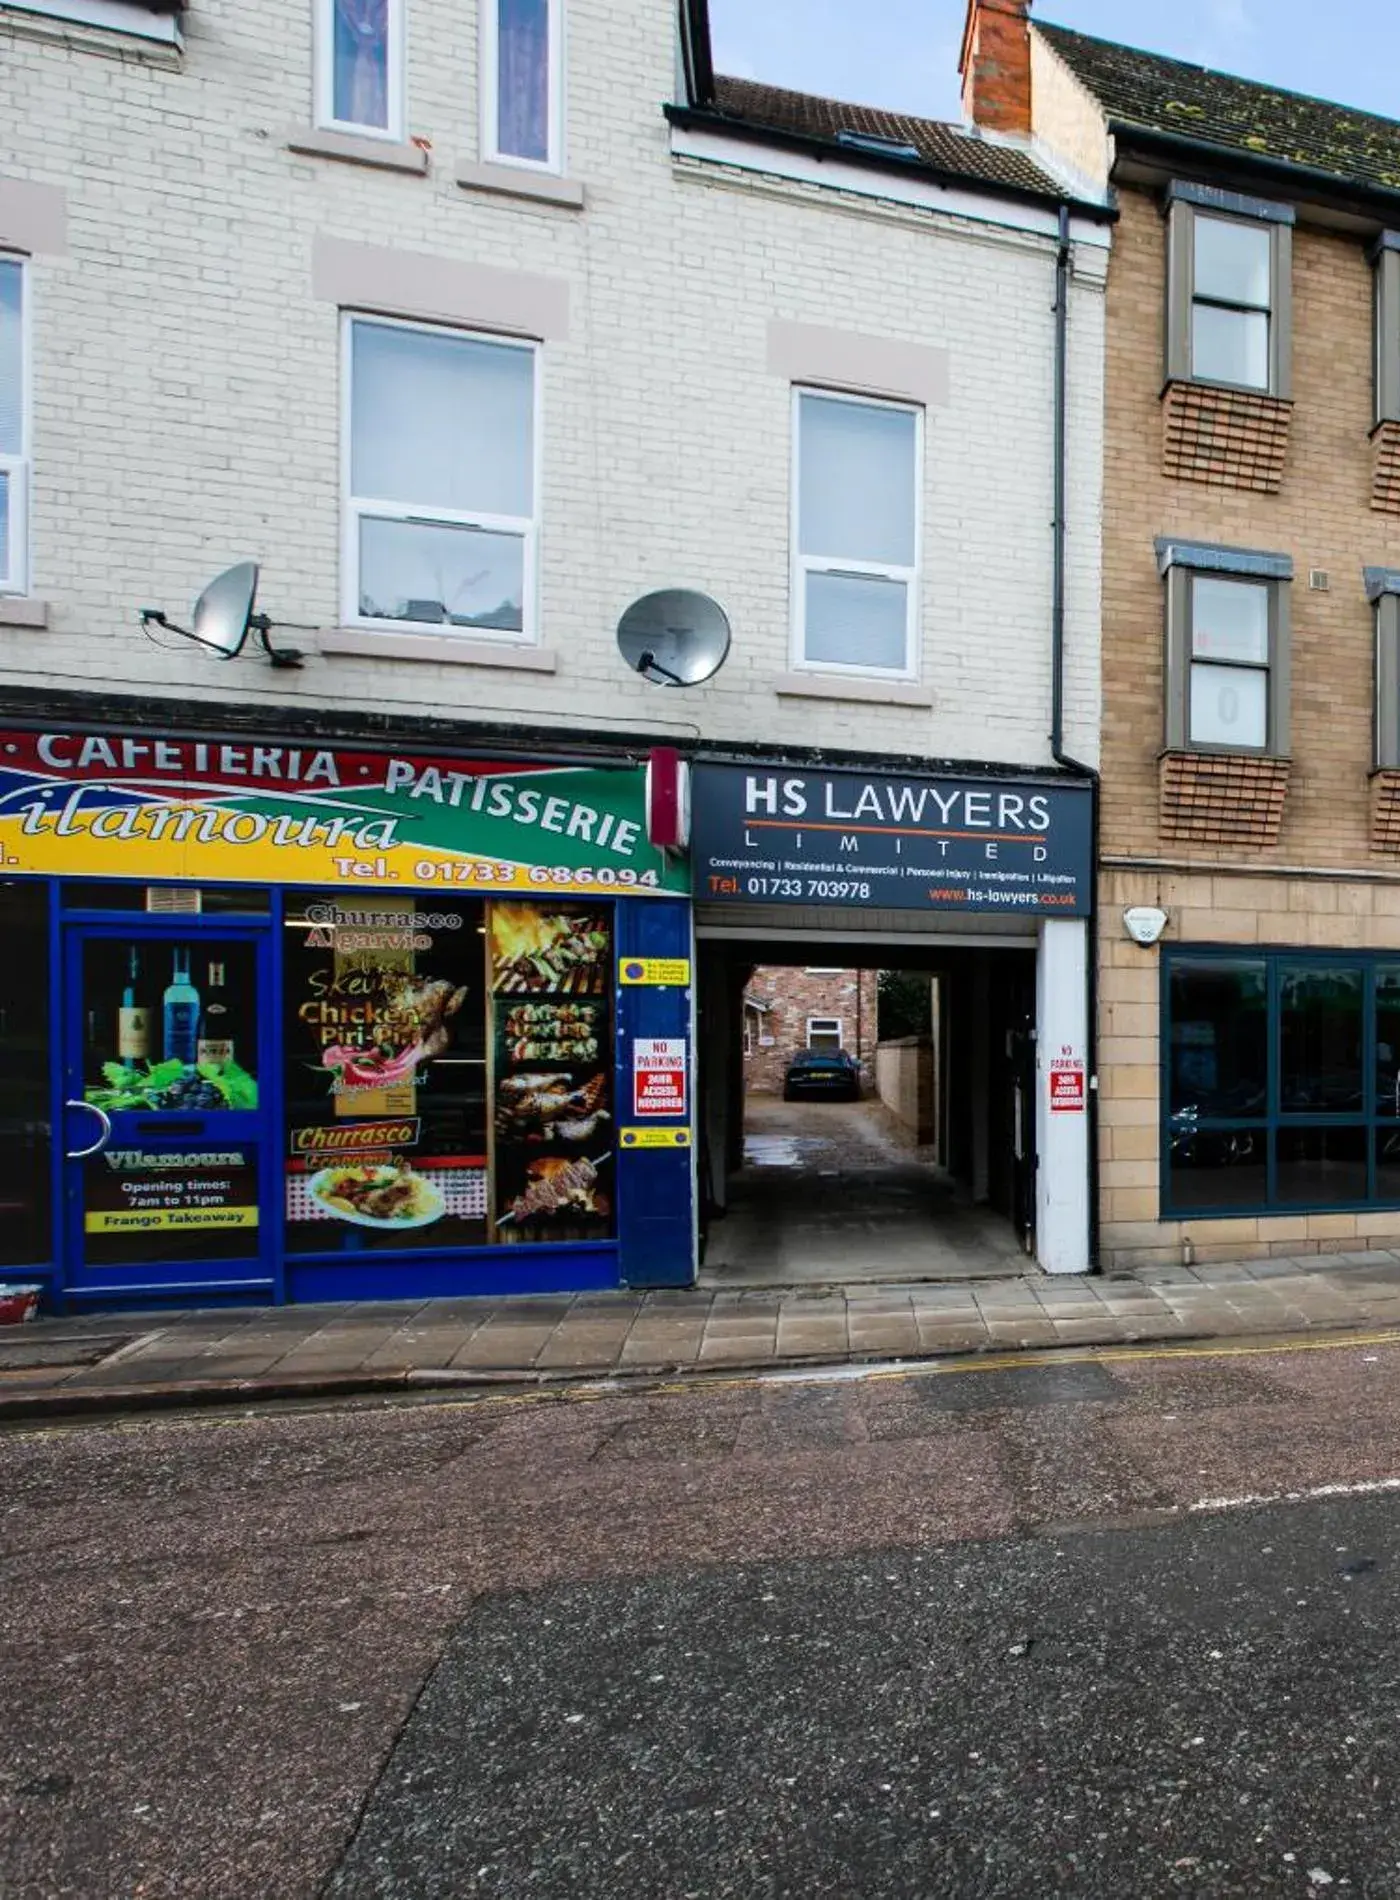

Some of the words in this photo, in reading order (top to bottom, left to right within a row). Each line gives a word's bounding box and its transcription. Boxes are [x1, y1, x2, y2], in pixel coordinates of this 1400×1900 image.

[37, 734, 340, 785] CAFETERIA
[384, 758, 642, 856] PATISSERIE
[745, 776, 807, 816] HS
[825, 781, 1051, 831] LAWYERS
[10, 784, 404, 850] ilamoura
[745, 830, 1047, 862] LIMITED
[332, 857, 399, 879] Tel.
[414, 860, 516, 883] 01733
[528, 864, 659, 889] 686094
[709, 874, 742, 894] Tel.
[748, 877, 802, 896] 01733
[807, 880, 870, 899] 703978
[928, 887, 1076, 906] www.hs-lawyers.co.uk
[305, 904, 464, 930] Churrasco
[303, 927, 433, 954] Algarvio
[298, 1000, 421, 1024] Chicken
[652, 1041, 668, 1054] NO
[637, 1055, 683, 1068] PARKING
[297, 1125, 413, 1149] Churrasco
[121, 1182, 184, 1194] Opening
[186, 1180, 232, 1192] times:
[128, 1196, 161, 1207] 7am
[164, 1196, 180, 1206] to
[184, 1195, 225, 1207] 11pm
[104, 1215, 162, 1227] Frango
[167, 1212, 245, 1225] Takeaway
